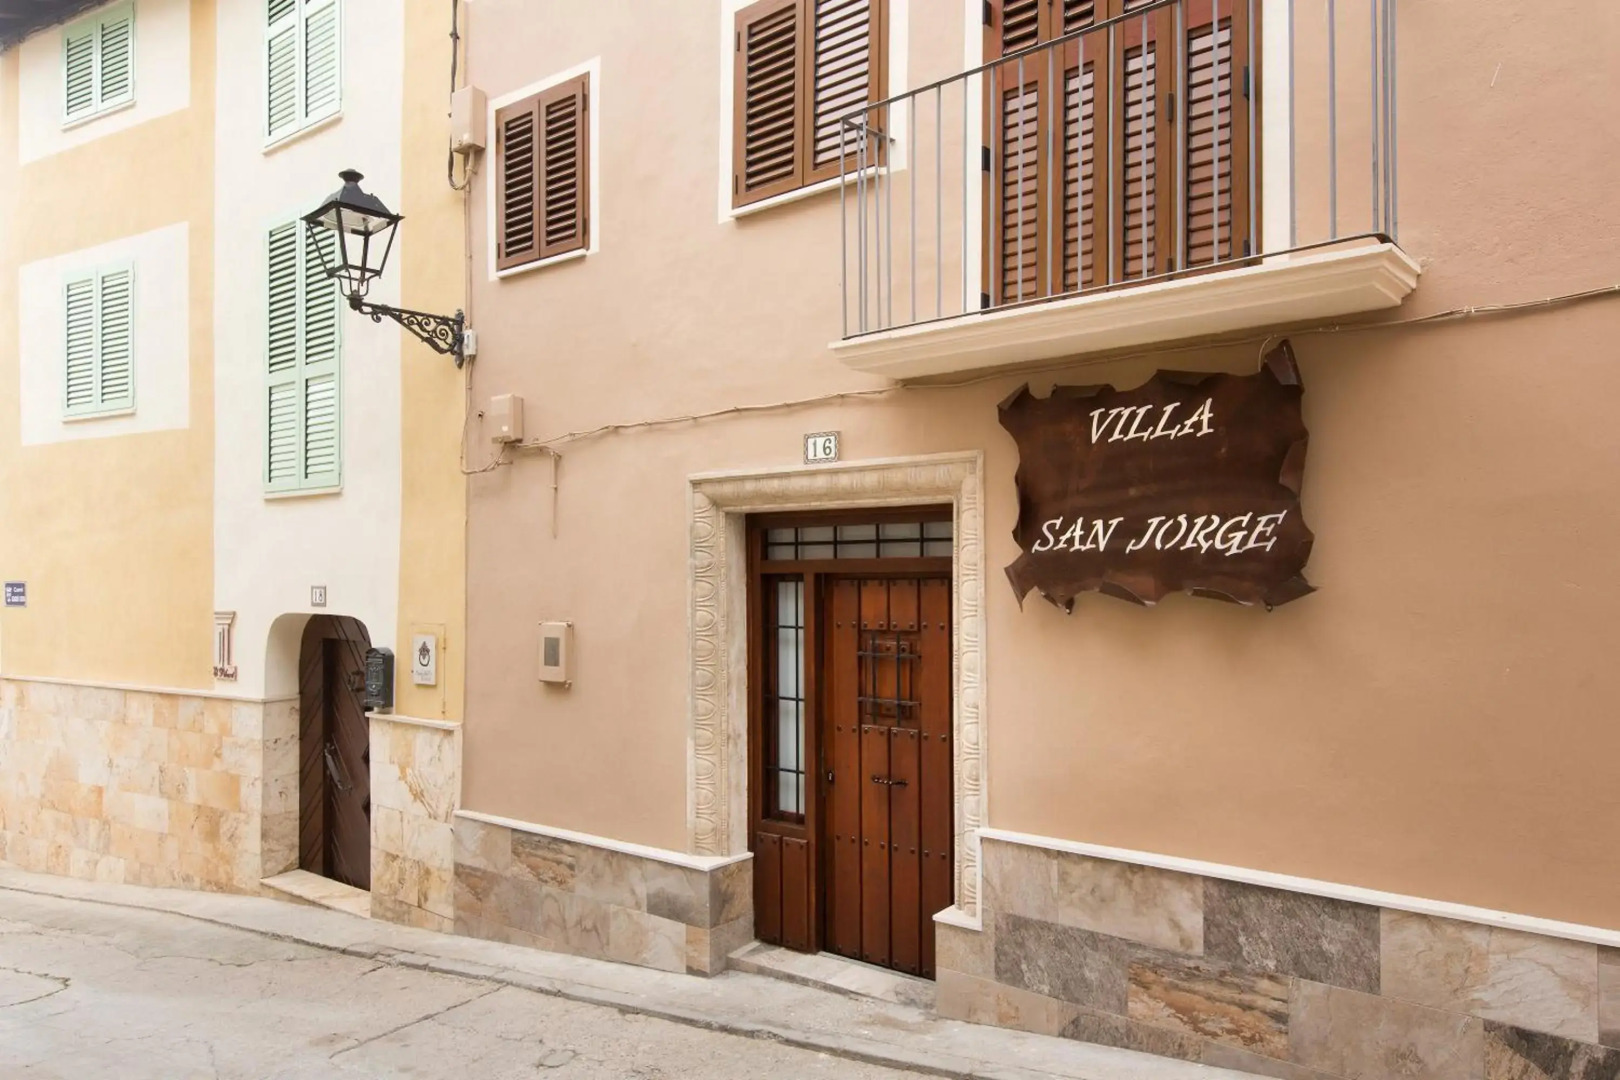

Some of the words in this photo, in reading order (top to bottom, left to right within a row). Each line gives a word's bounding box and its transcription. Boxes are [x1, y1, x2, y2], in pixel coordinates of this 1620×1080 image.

[1089, 397, 1214, 444] VILLA
[812, 437, 833, 457] 16
[1031, 516, 1124, 554] SAN
[1126, 510, 1288, 557] JORGE
[314, 589, 324, 602] 18
